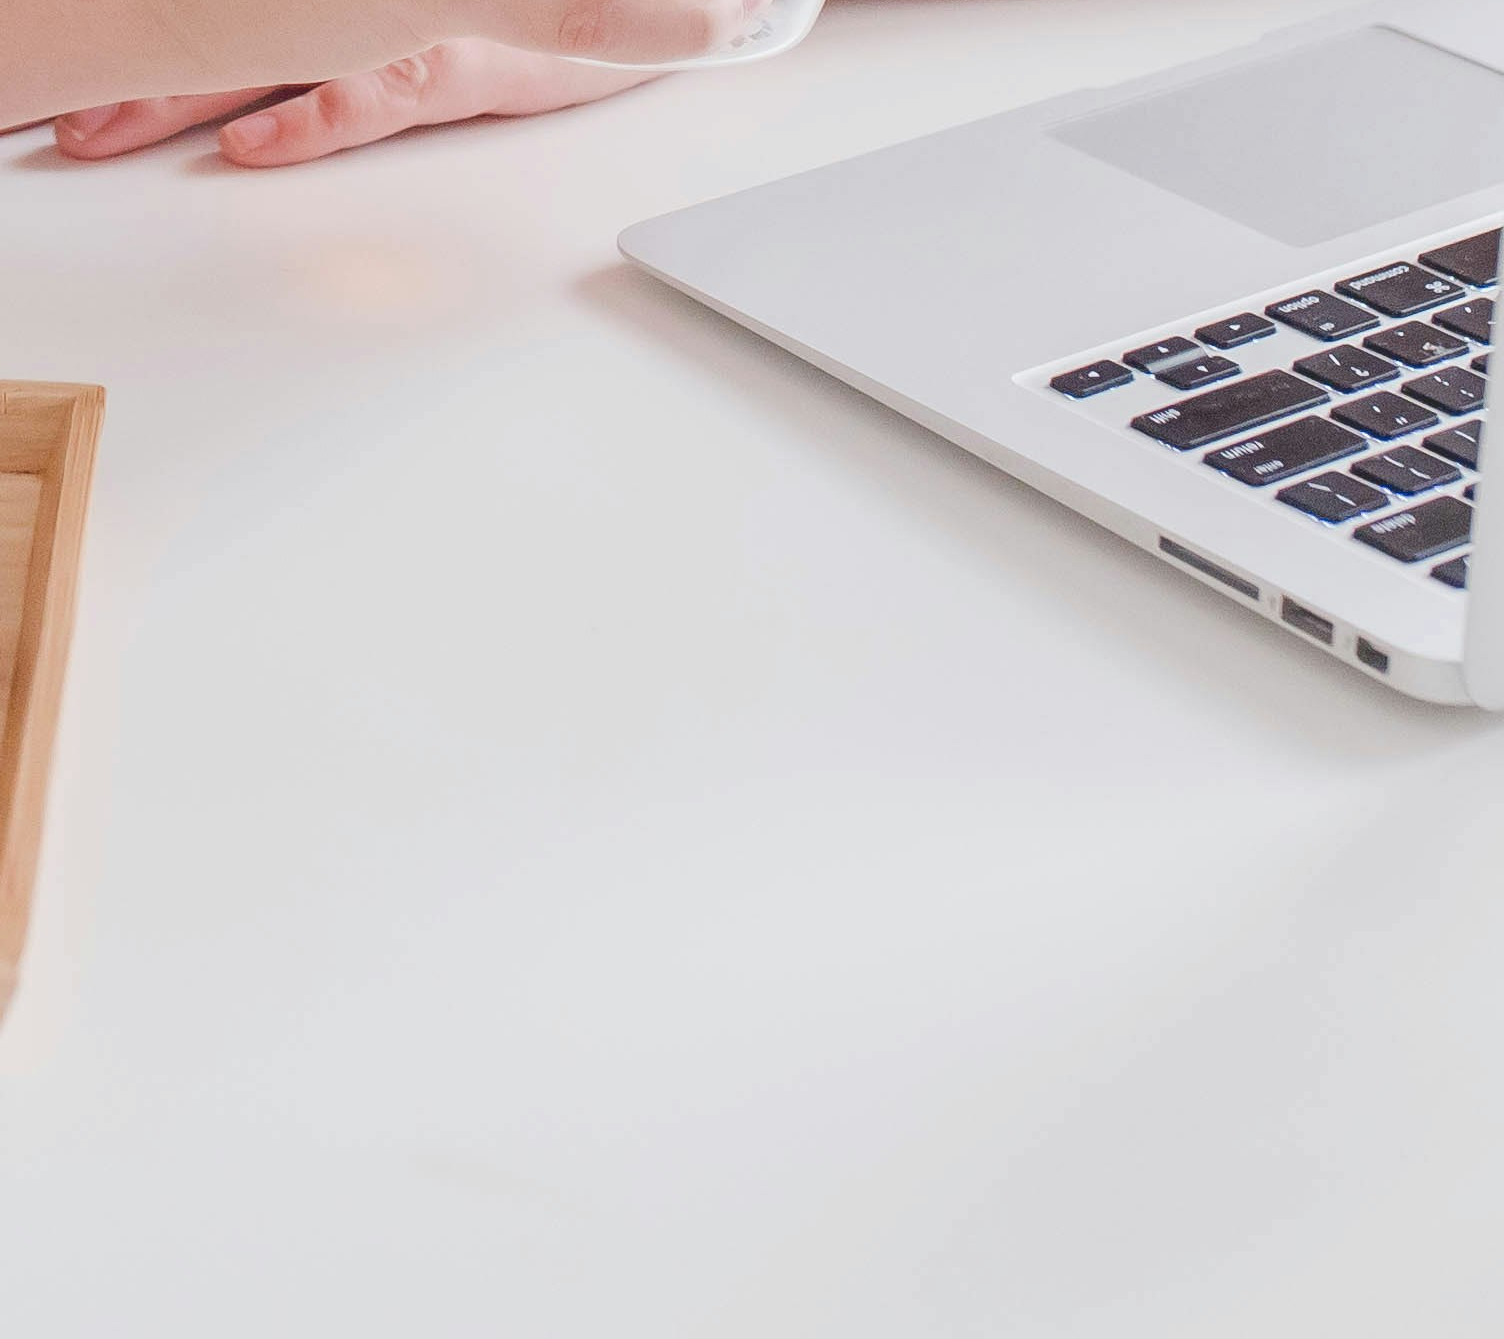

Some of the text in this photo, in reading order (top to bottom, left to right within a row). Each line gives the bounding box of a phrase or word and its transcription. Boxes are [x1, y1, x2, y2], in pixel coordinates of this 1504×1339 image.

[1348, 265, 1410, 291] command
[1278, 296, 1320, 313] option
[1148, 408, 1181, 424] shift
[1220, 440, 1265, 460] return
[1253, 460, 1284, 475] enter
